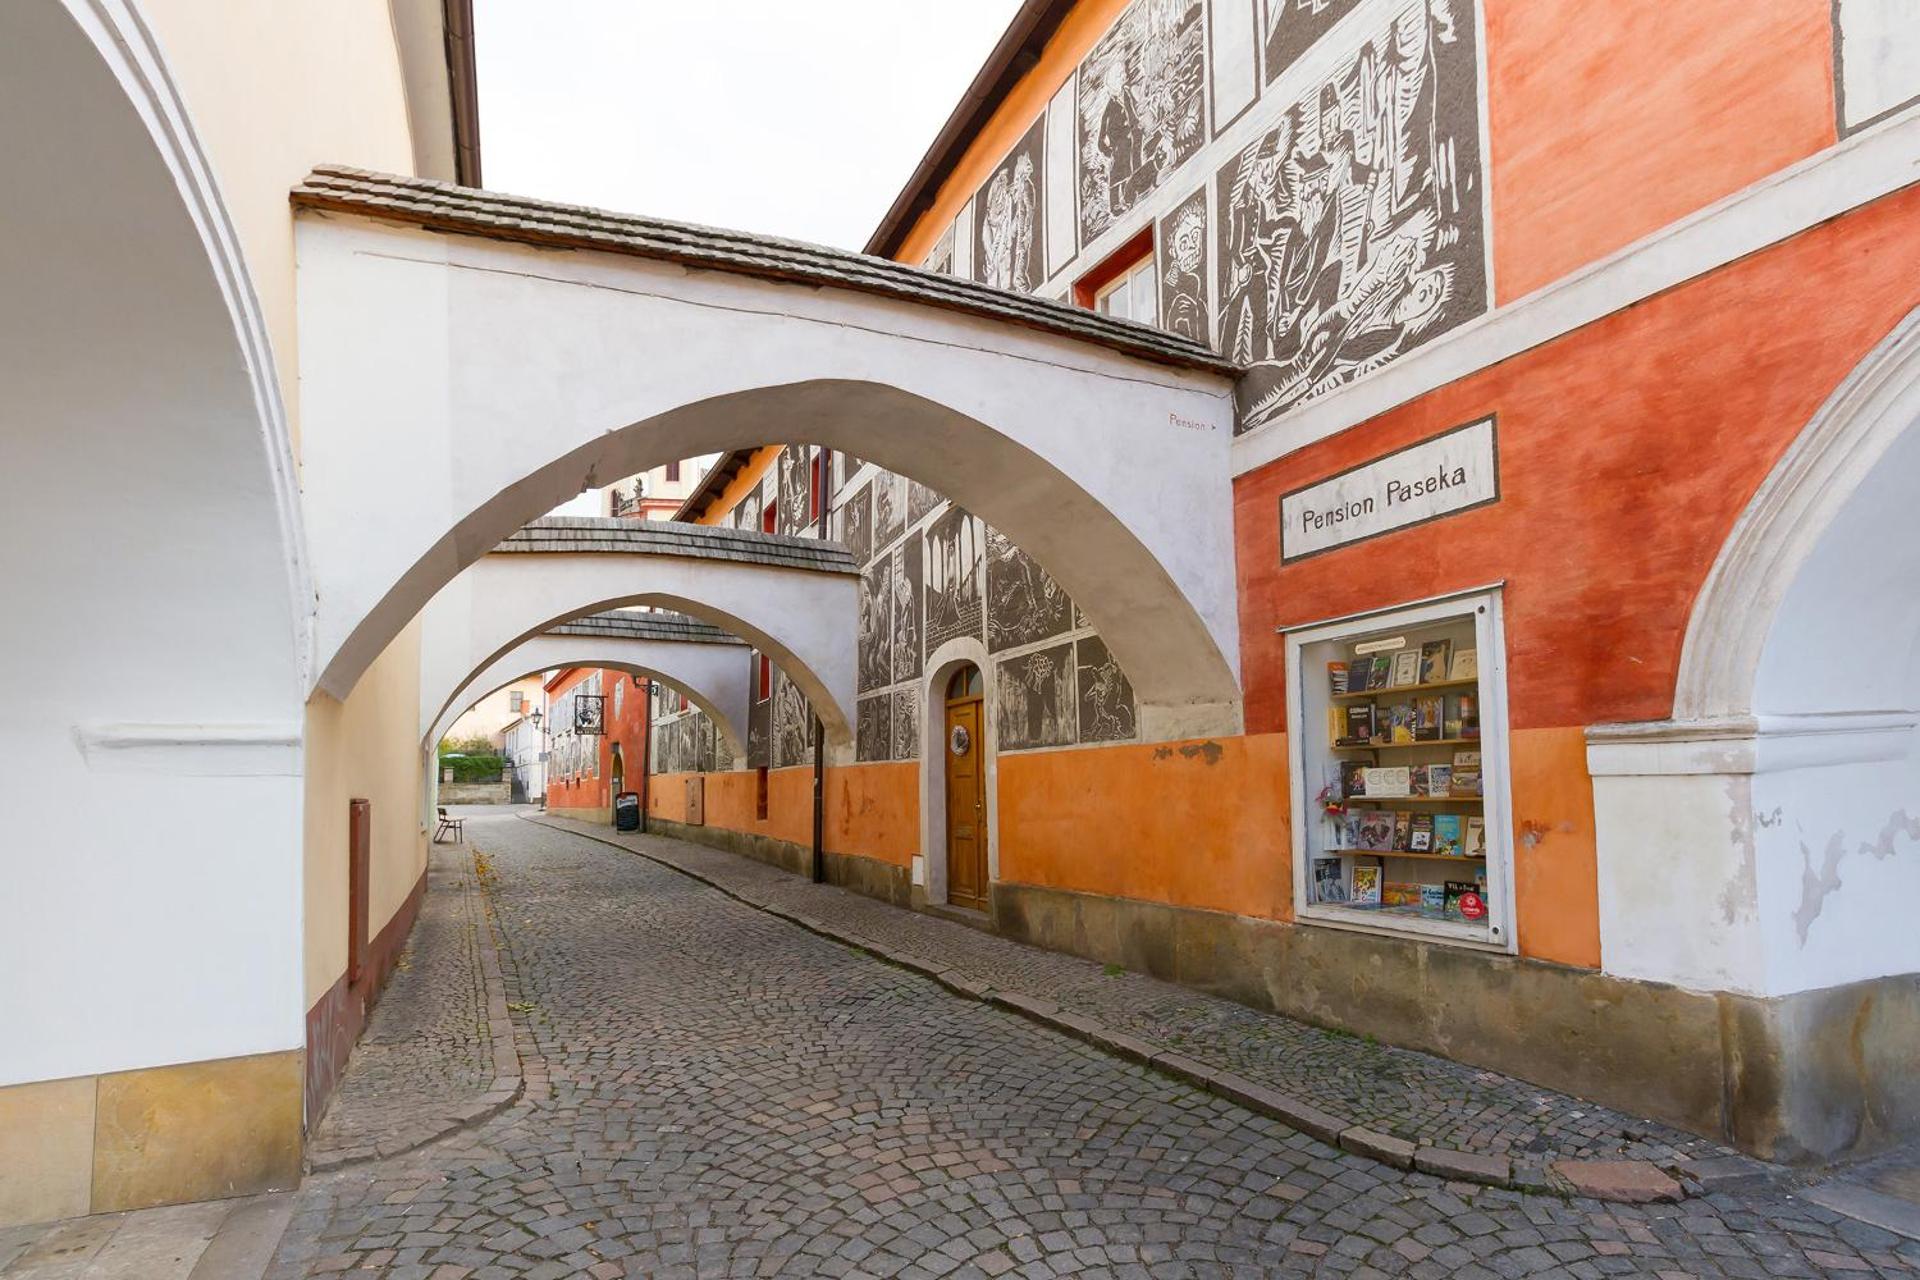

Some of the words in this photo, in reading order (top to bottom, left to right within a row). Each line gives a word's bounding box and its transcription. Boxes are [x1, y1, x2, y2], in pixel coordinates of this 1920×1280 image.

[1169, 413, 1205, 430] Pension
[1302, 496, 1374, 533] Pension
[1386, 464, 1467, 506] Paseka
